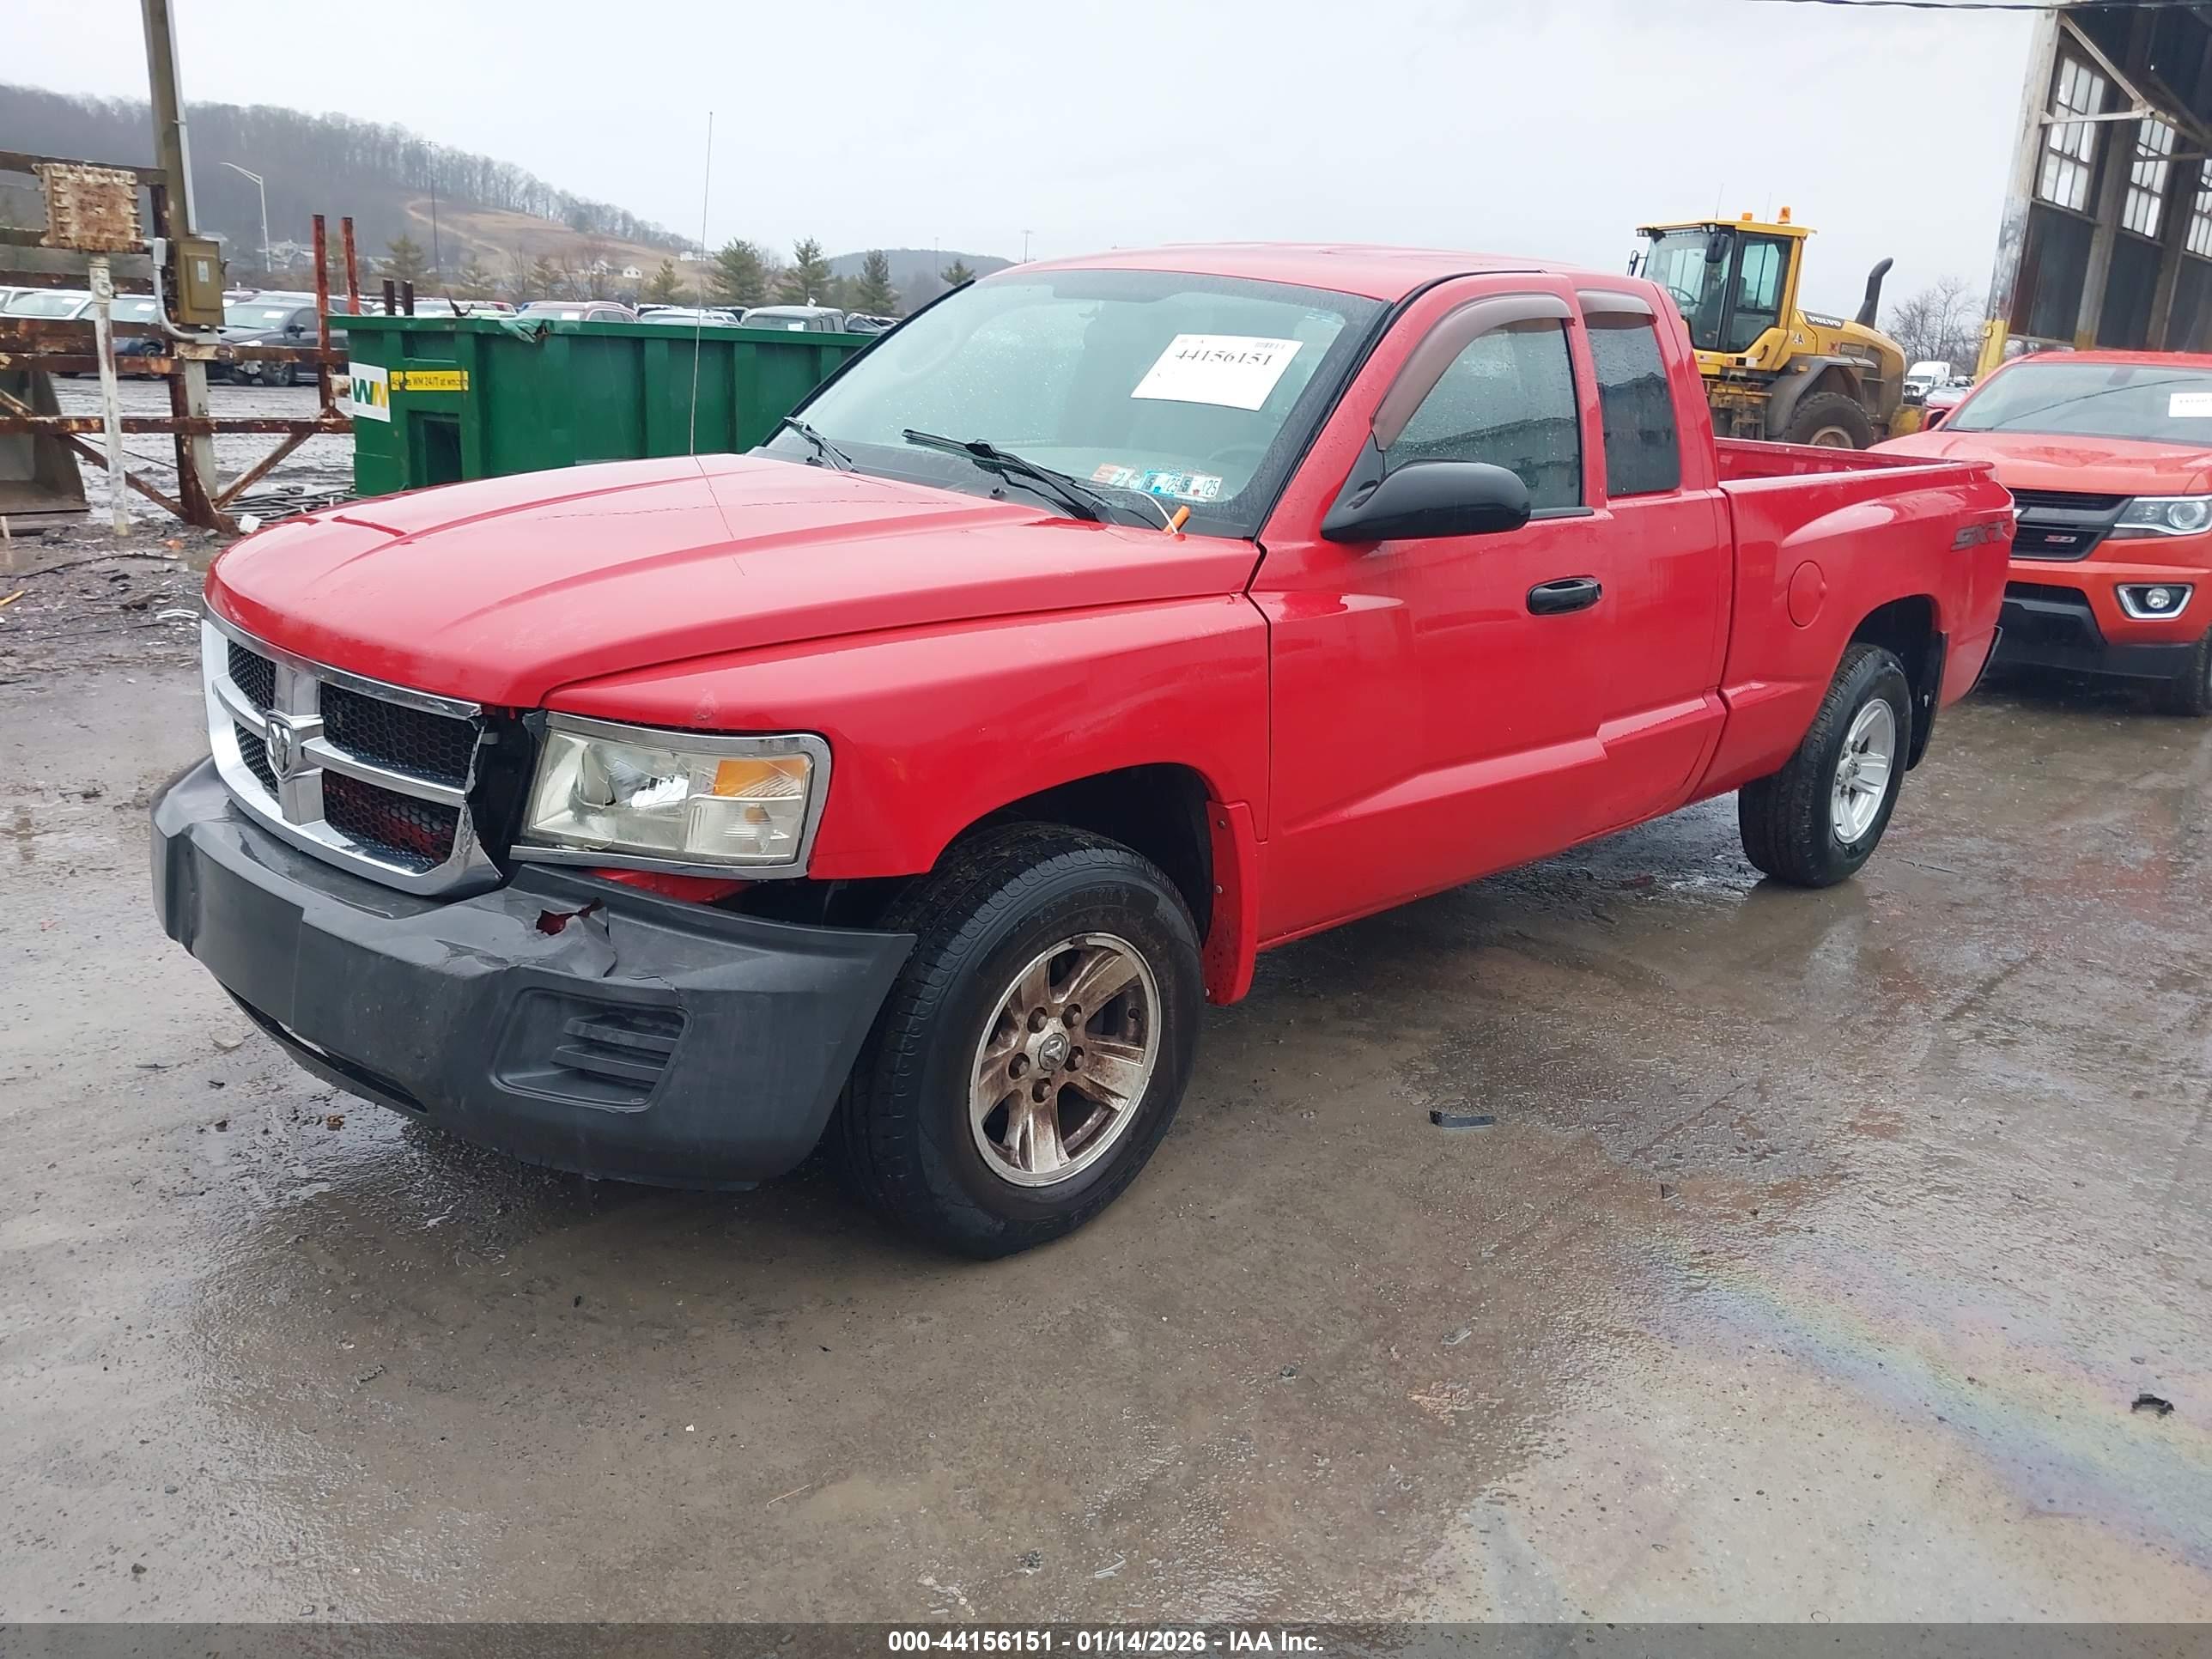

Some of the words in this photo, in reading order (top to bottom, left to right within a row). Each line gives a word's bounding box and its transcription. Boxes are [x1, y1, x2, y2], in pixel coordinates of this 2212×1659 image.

[1808, 315, 1842, 327] VOLVO
[1175, 349, 1273, 366] 44156151
[352, 376, 388, 408] WM
[1951, 520, 2009, 551] SXT
